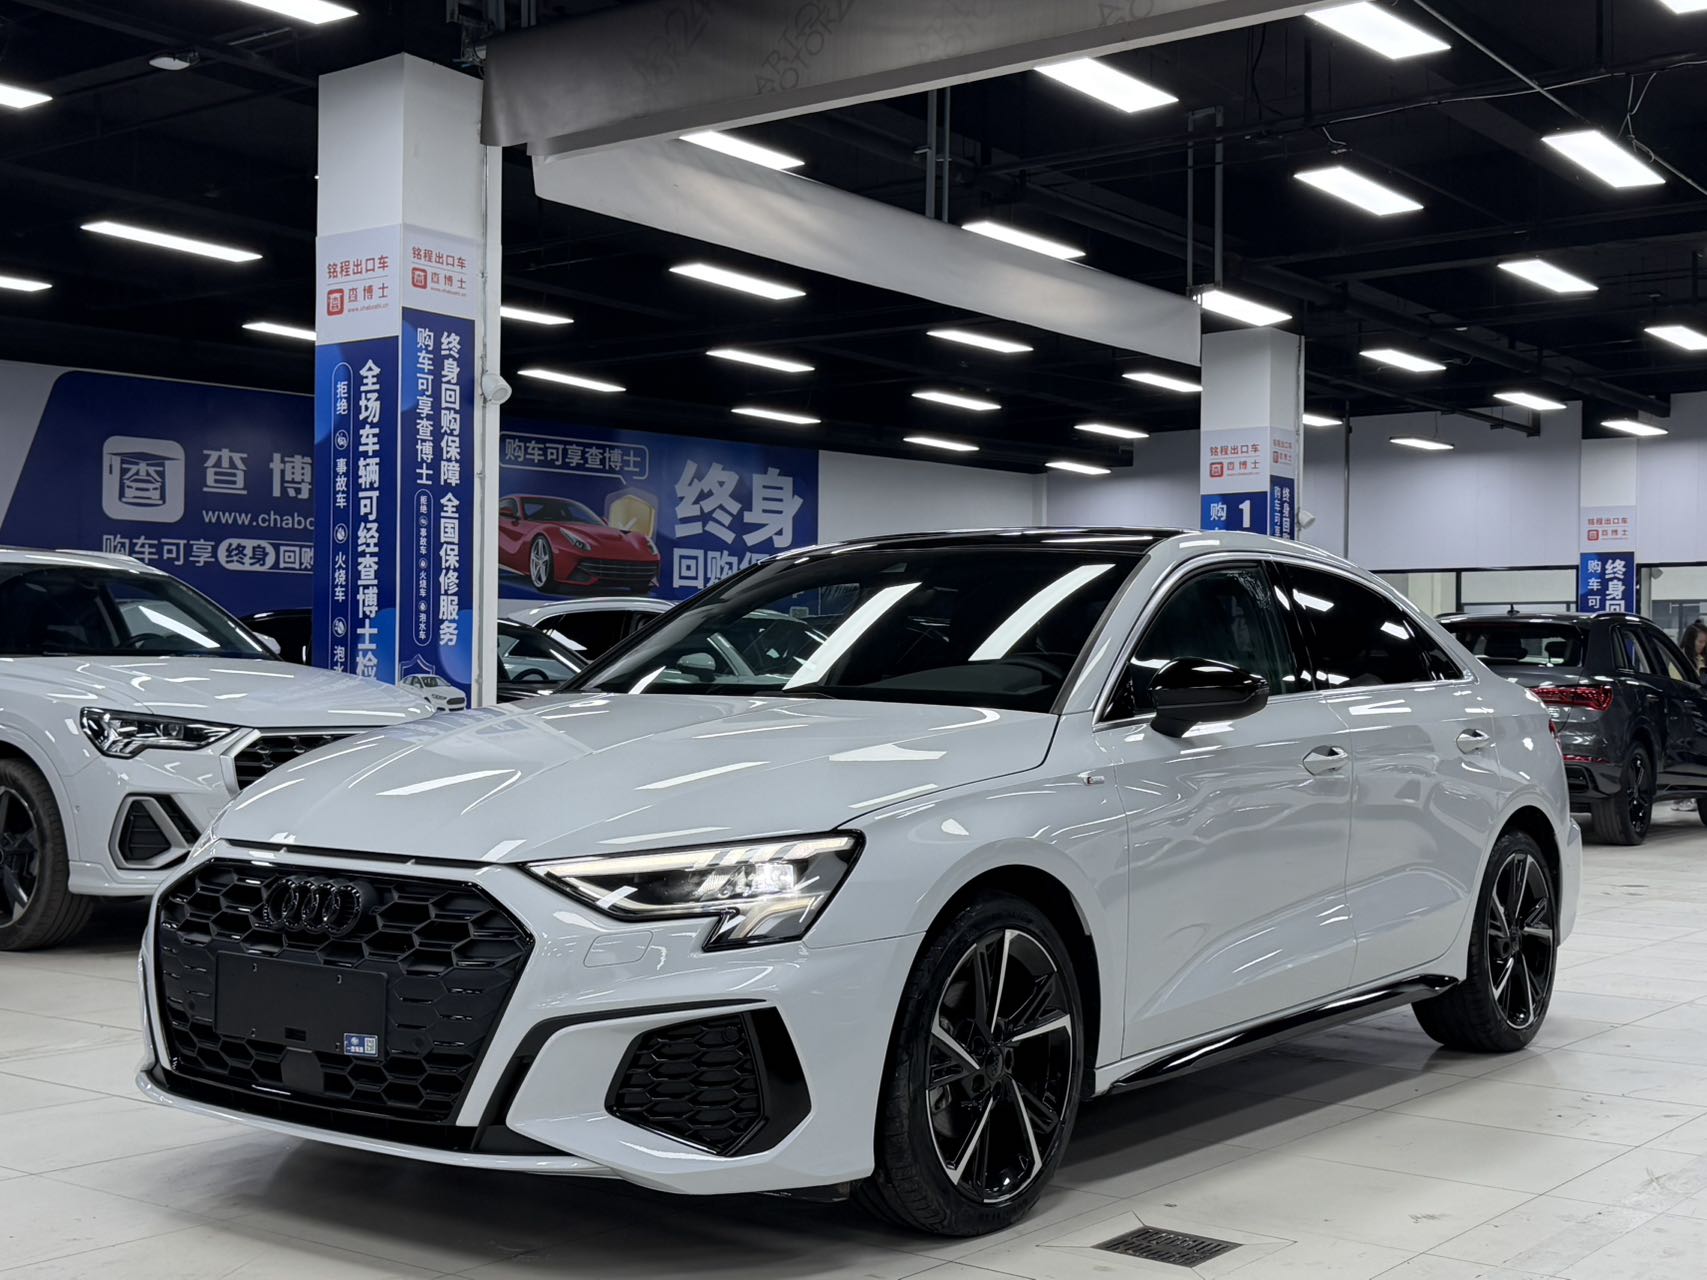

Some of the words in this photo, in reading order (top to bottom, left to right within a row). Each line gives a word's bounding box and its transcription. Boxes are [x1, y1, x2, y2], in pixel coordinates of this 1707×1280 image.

[327, 254, 388, 279] 铭程出口车
[412, 246, 466, 269] 铭程出口车
[335, 381, 348, 416] 拒绝
[415, 327, 434, 485] 购车可享查博士
[440, 331, 462, 486] 终身回购保障
[505, 438, 641, 472] 购车可享查博士
[335, 458, 348, 509] 事故车
[673, 459, 804, 548] 终身
[1238, 500, 1251, 529] 1
[334, 551, 347, 602] 火烧车
[439, 492, 461, 646] 全国保修服务
[1587, 559, 1602, 609] 购车可
